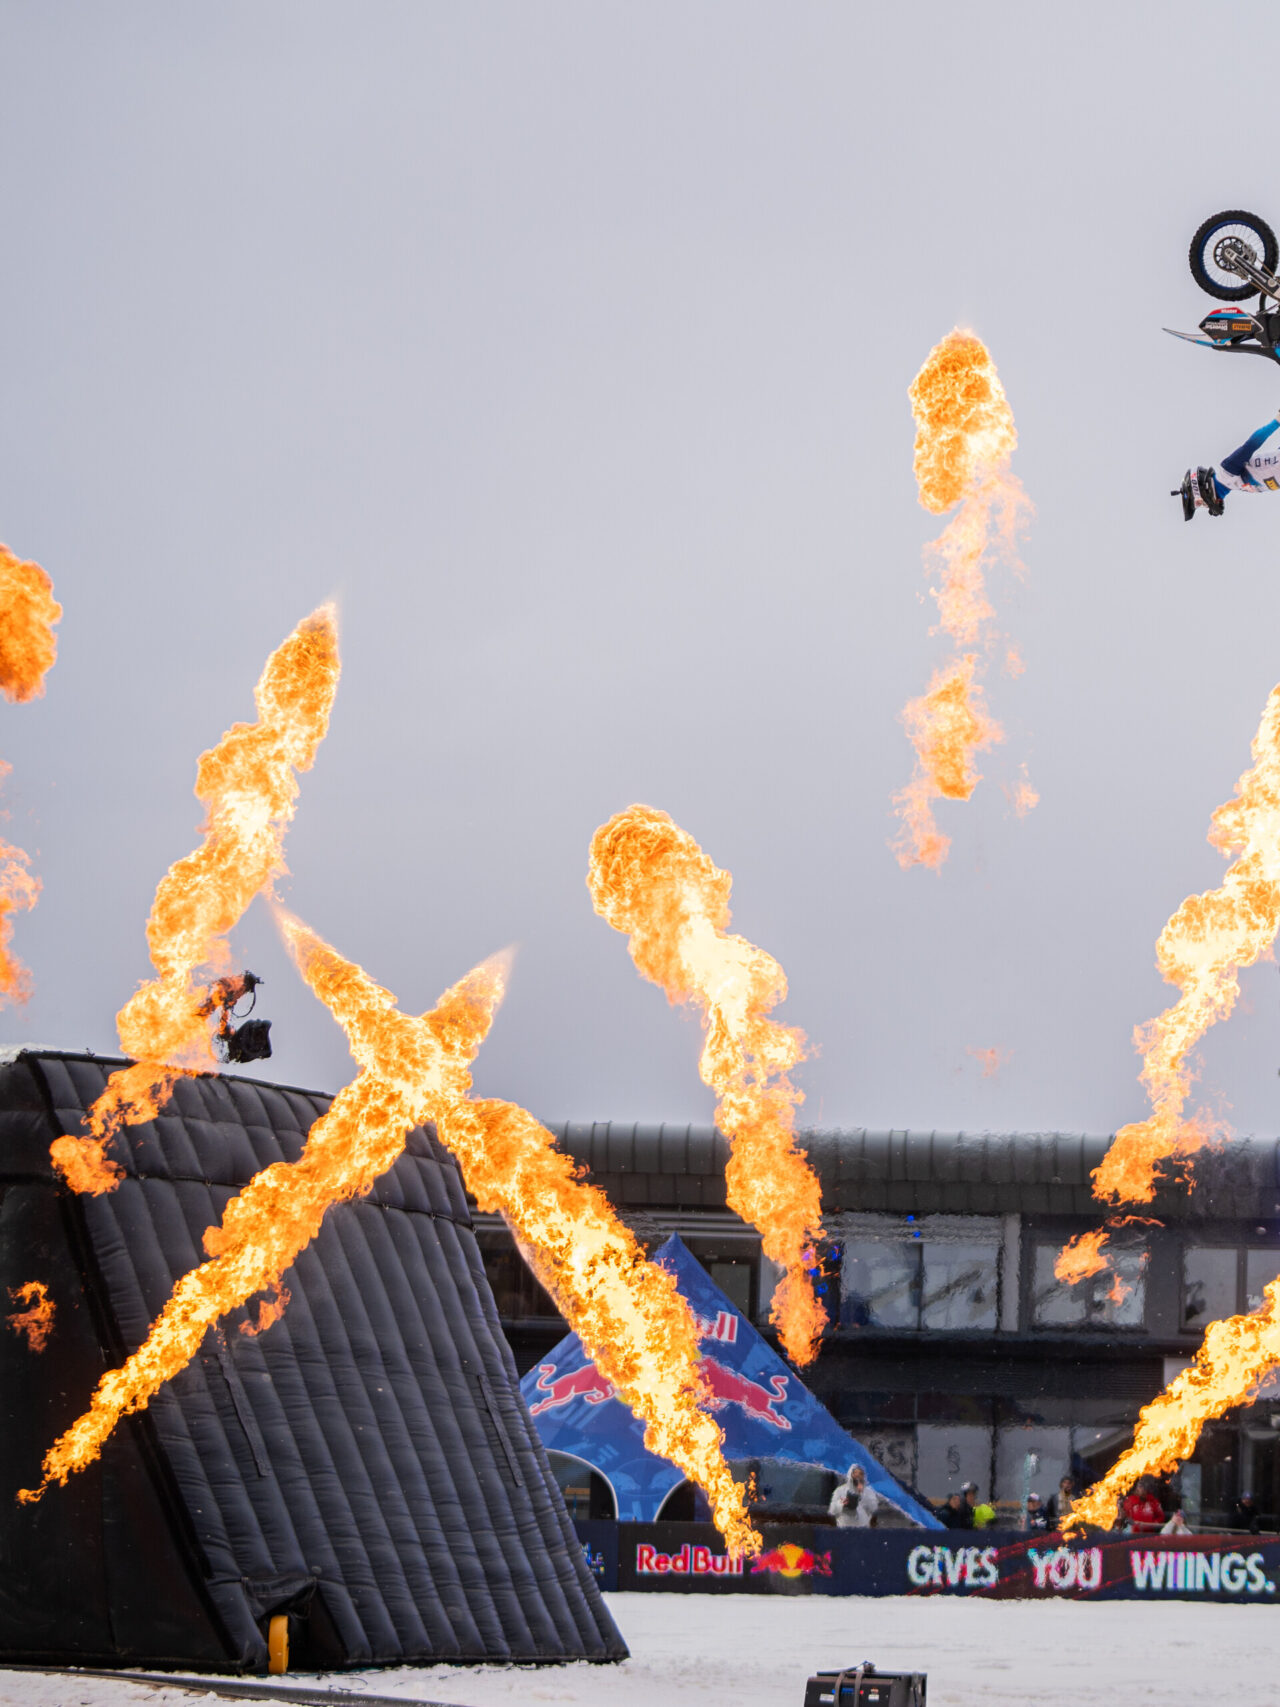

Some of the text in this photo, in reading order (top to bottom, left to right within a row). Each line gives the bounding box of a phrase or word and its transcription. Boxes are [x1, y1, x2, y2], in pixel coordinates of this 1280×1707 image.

[637, 1543, 690, 1574] Red
[691, 1545, 743, 1575] Bull
[907, 1546, 1276, 1594] GIVES YOU WIIINGS.
